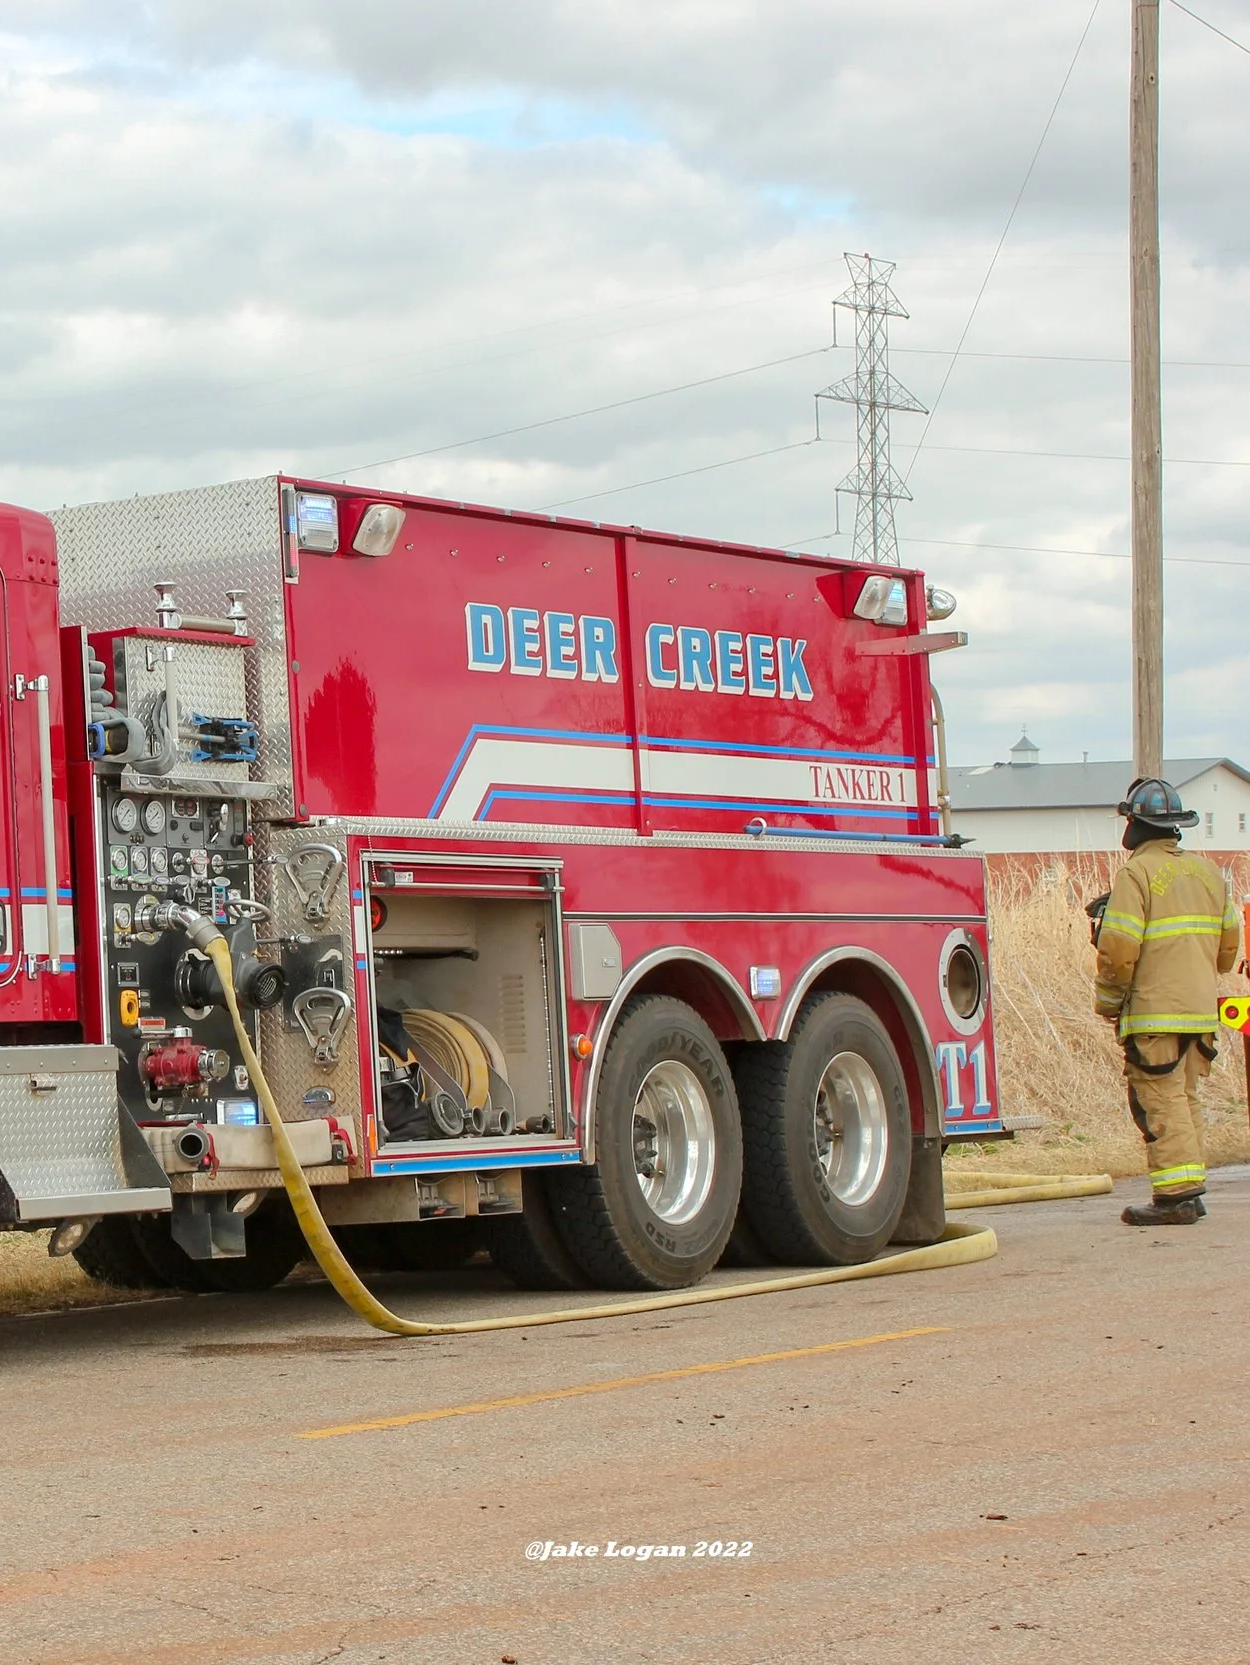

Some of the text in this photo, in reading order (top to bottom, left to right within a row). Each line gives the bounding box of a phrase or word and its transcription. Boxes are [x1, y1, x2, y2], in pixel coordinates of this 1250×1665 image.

[464, 601, 814, 702] DEER CREEK
[809, 765, 906, 803] TANKER 1
[936, 1039, 991, 1118] T1
